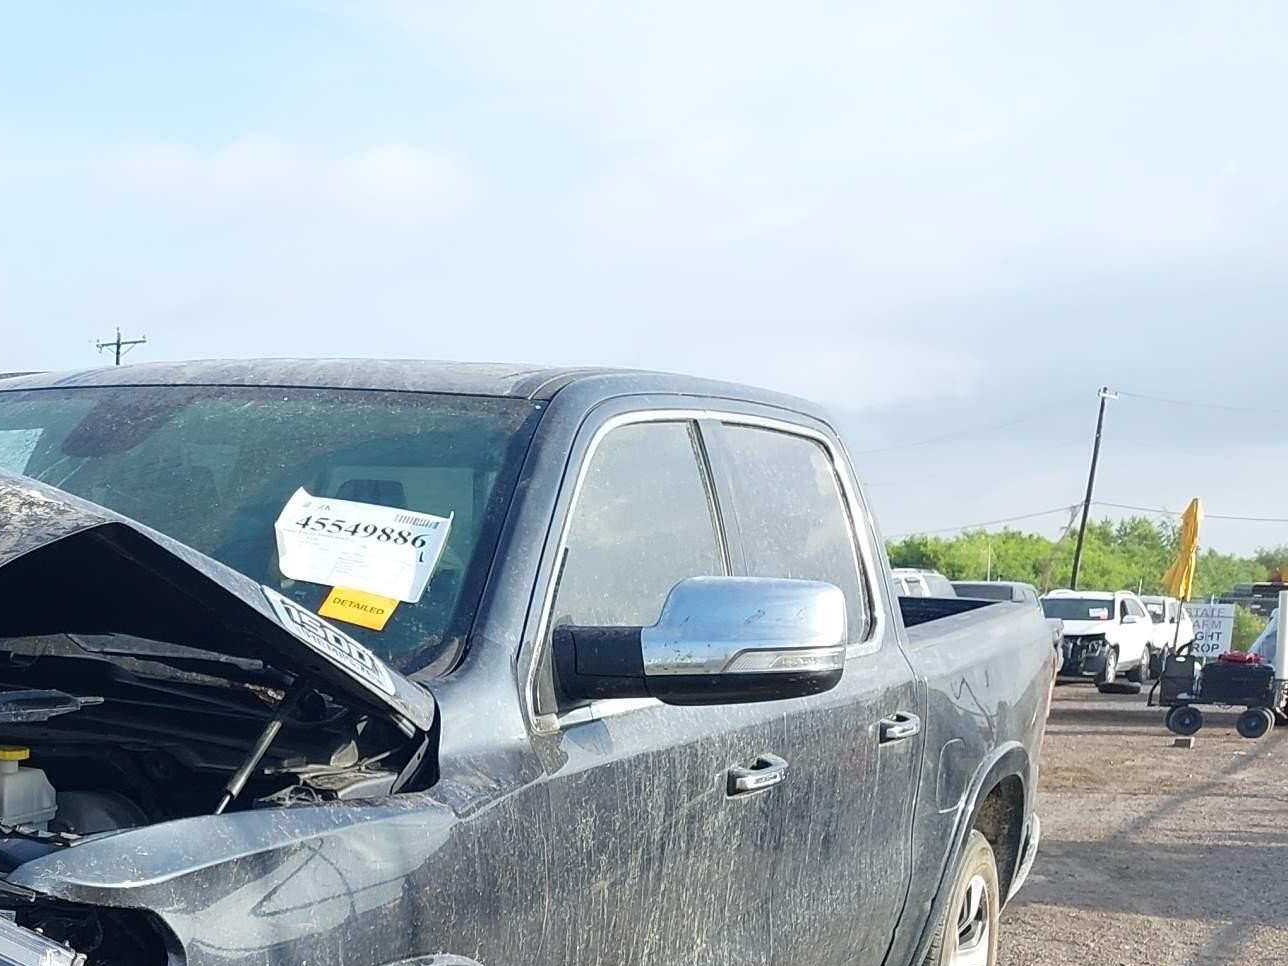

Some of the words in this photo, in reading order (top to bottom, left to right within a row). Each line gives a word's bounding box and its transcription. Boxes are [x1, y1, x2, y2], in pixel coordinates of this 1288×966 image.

[296, 515, 430, 549] 45549886
[332, 597, 385, 616] DETAILED
[280, 599, 379, 672] 1500
[1191, 642, 1220, 653] ROP
